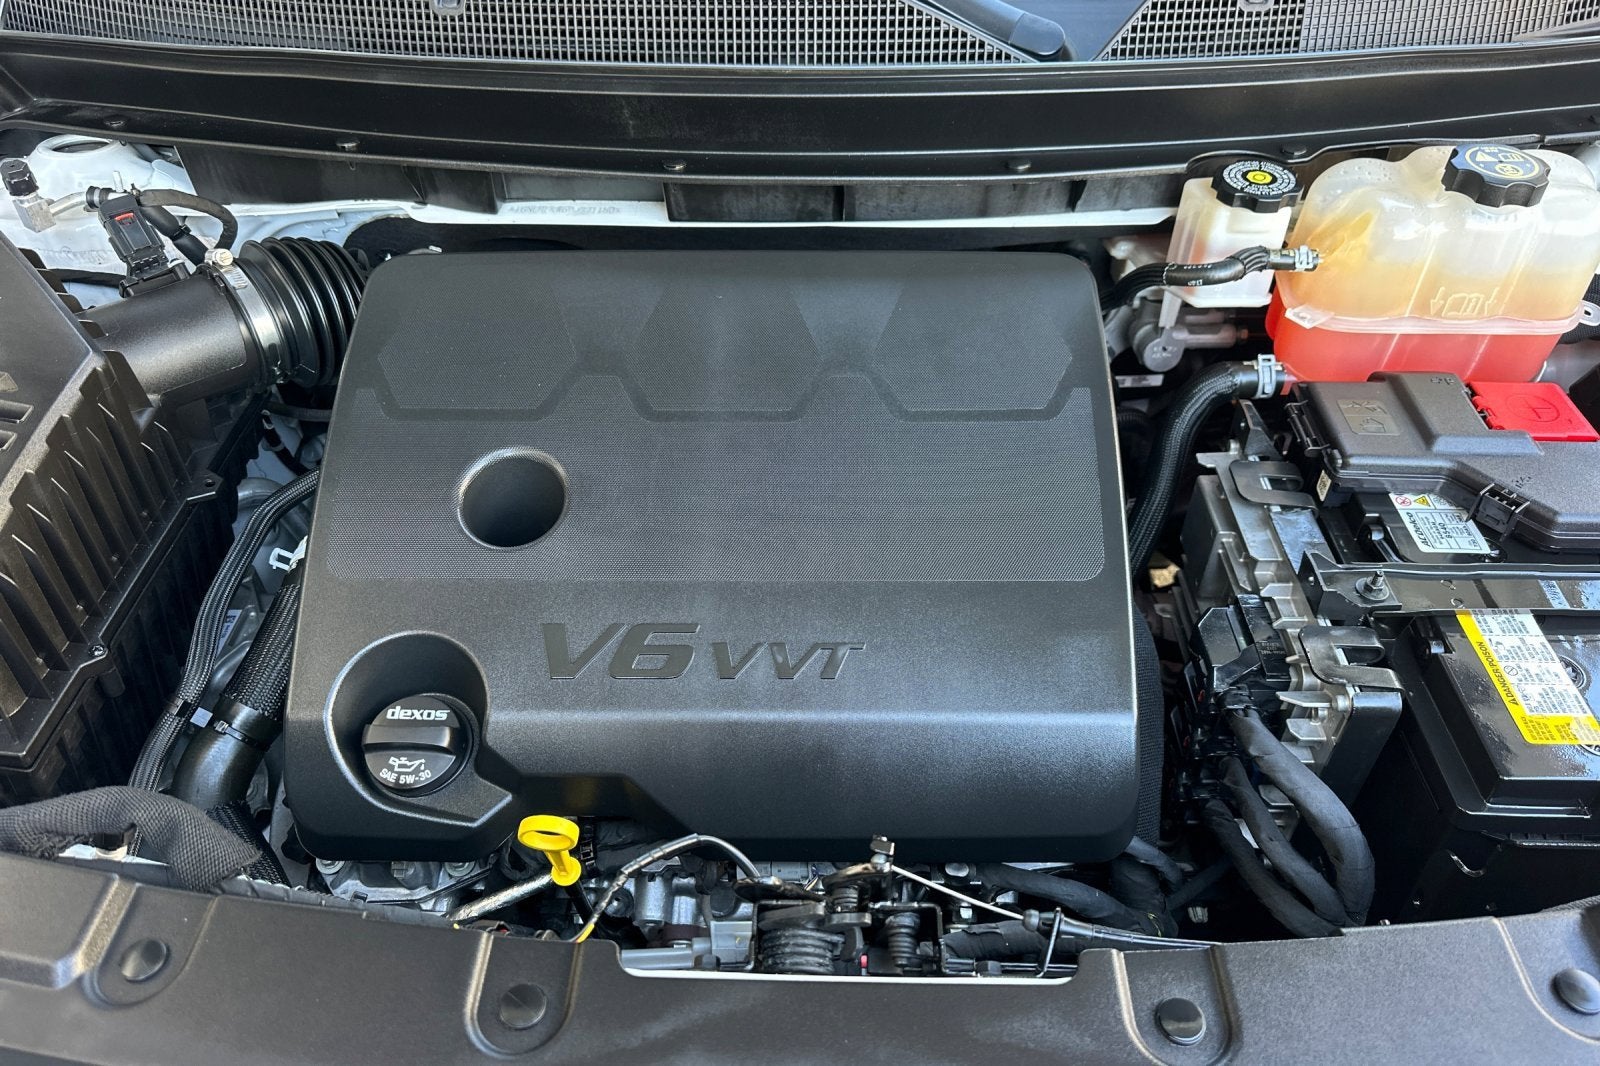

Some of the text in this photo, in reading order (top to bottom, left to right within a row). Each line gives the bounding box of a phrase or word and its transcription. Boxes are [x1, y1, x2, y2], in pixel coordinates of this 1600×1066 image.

[1406, 511, 1432, 548] ACDelco
[542, 622, 867, 680] V6 VVT
[386, 705, 450, 720] dexos
[379, 767, 432, 785] SAE 5W-30
